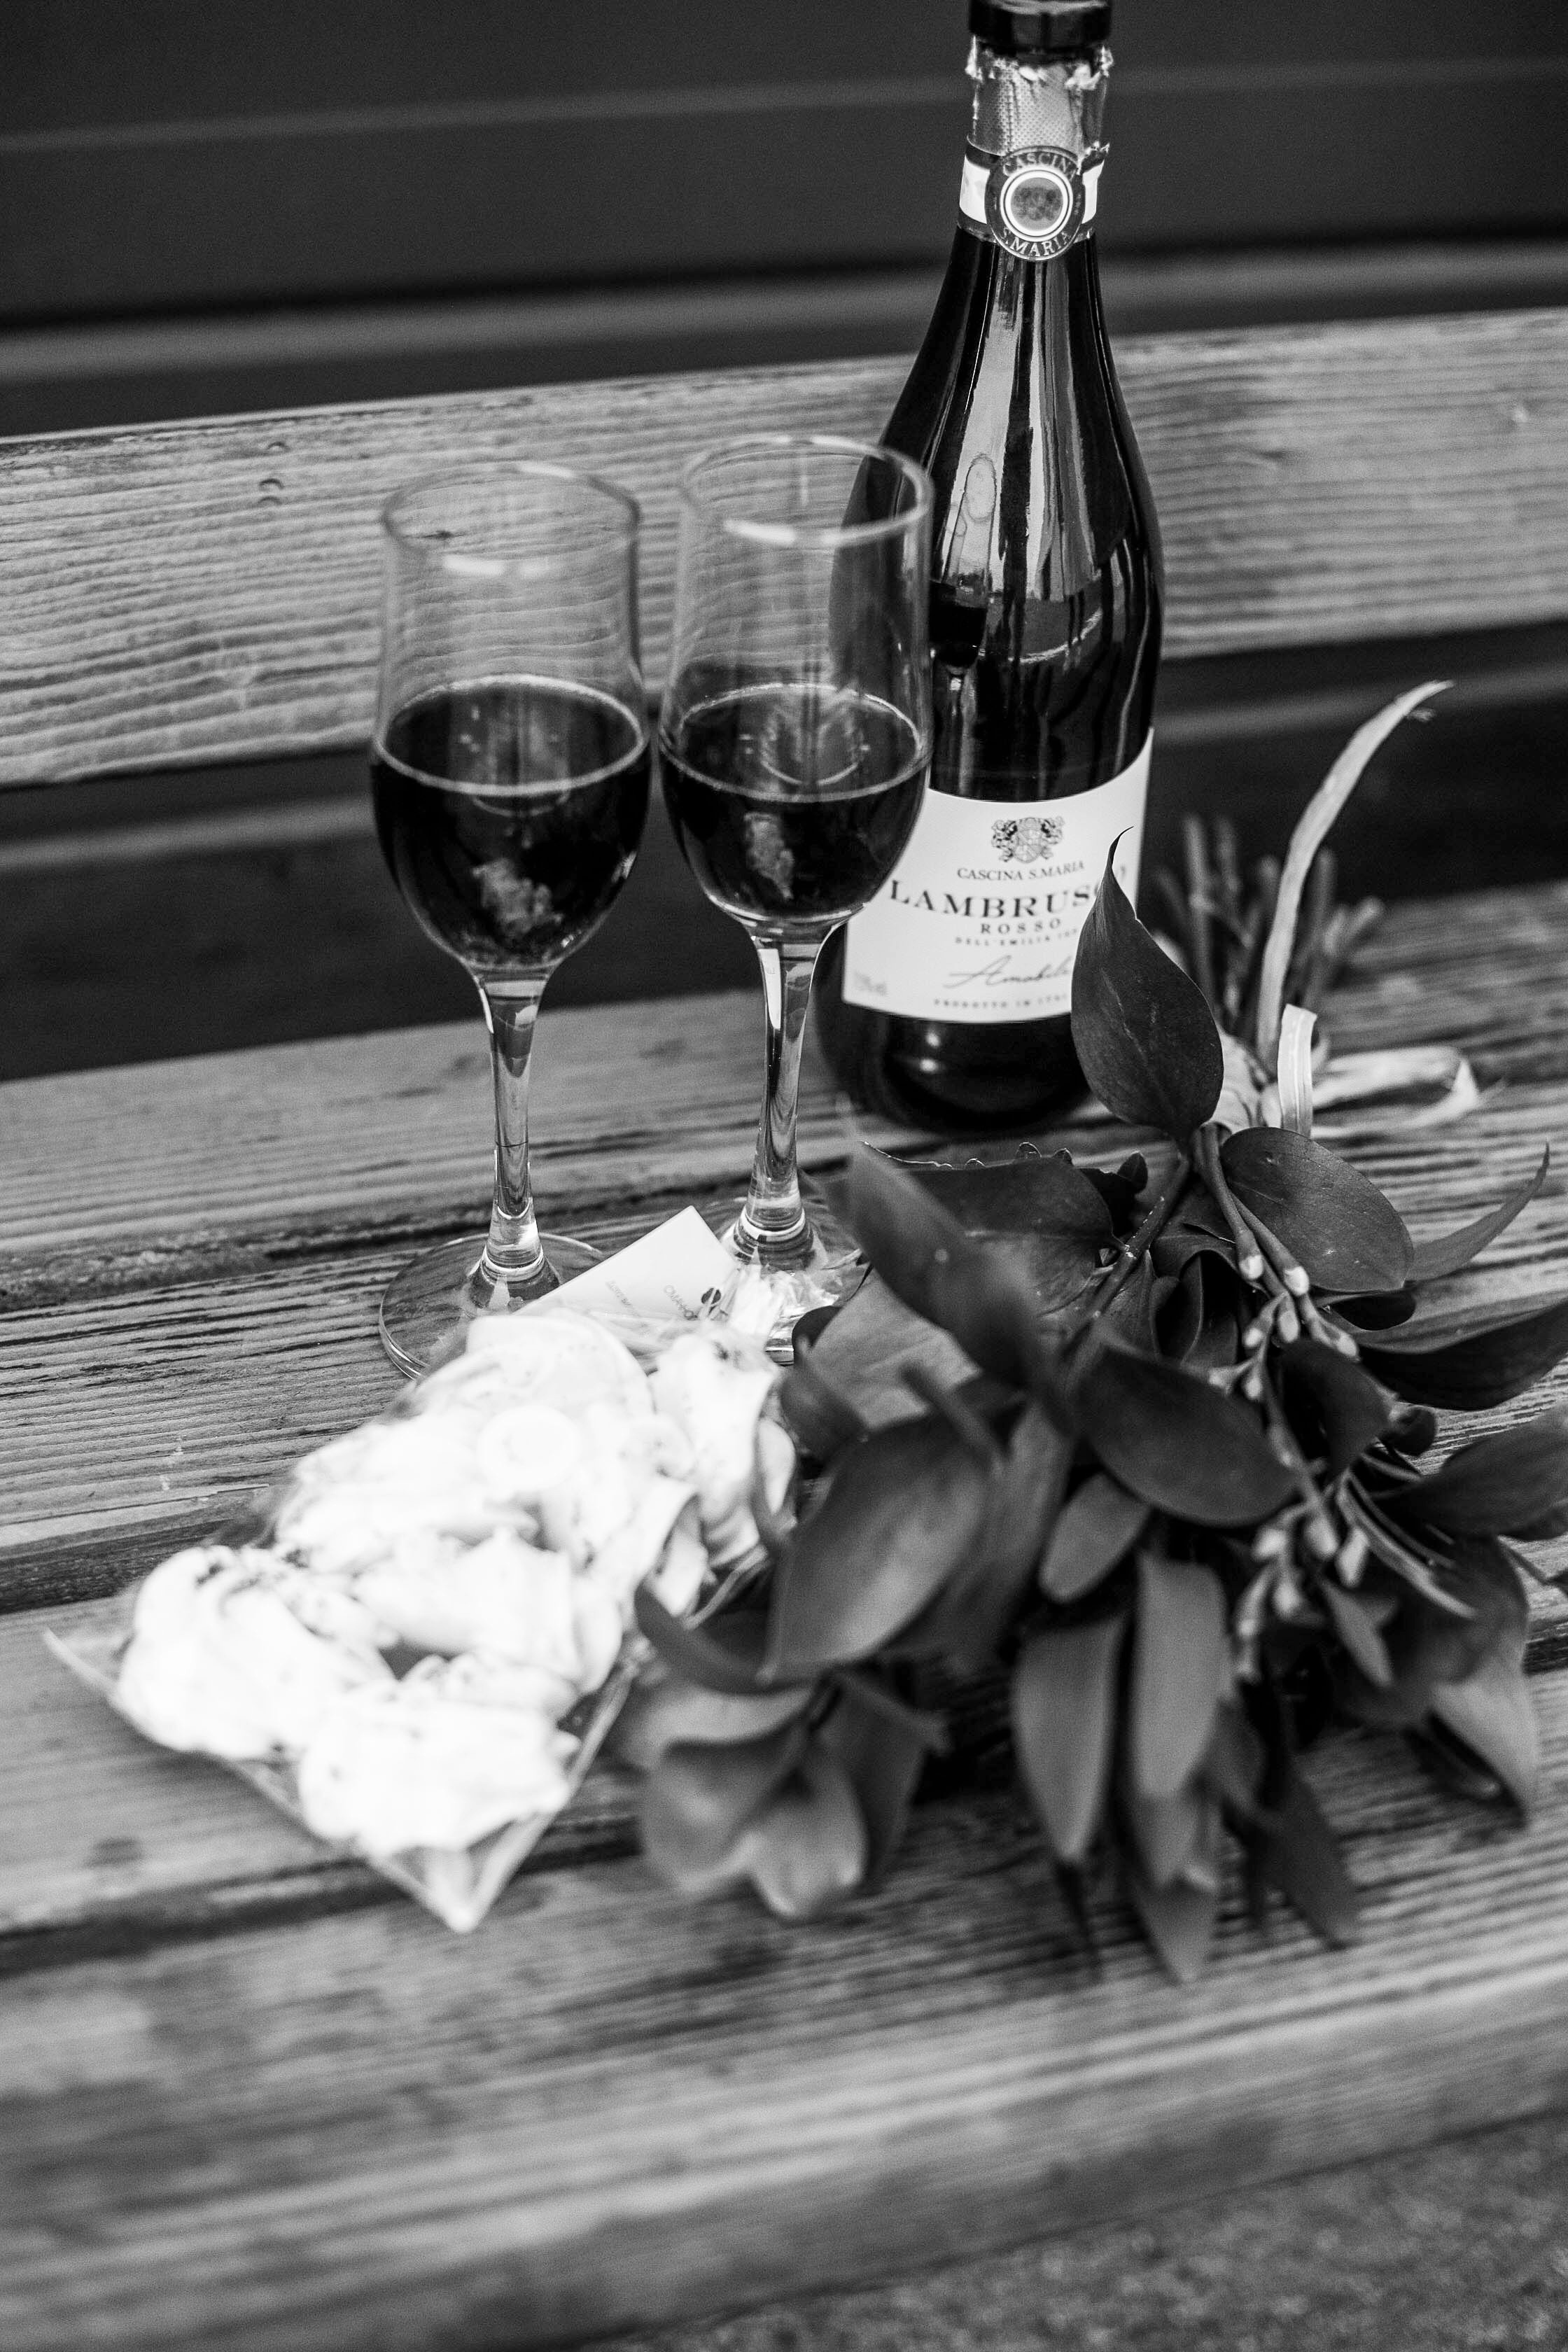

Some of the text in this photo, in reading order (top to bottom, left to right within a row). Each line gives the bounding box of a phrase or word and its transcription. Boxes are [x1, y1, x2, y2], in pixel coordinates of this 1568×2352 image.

[957, 860, 1085, 881] CASCINA S.MARIA
[980, 918, 1061, 935] ROSSO
